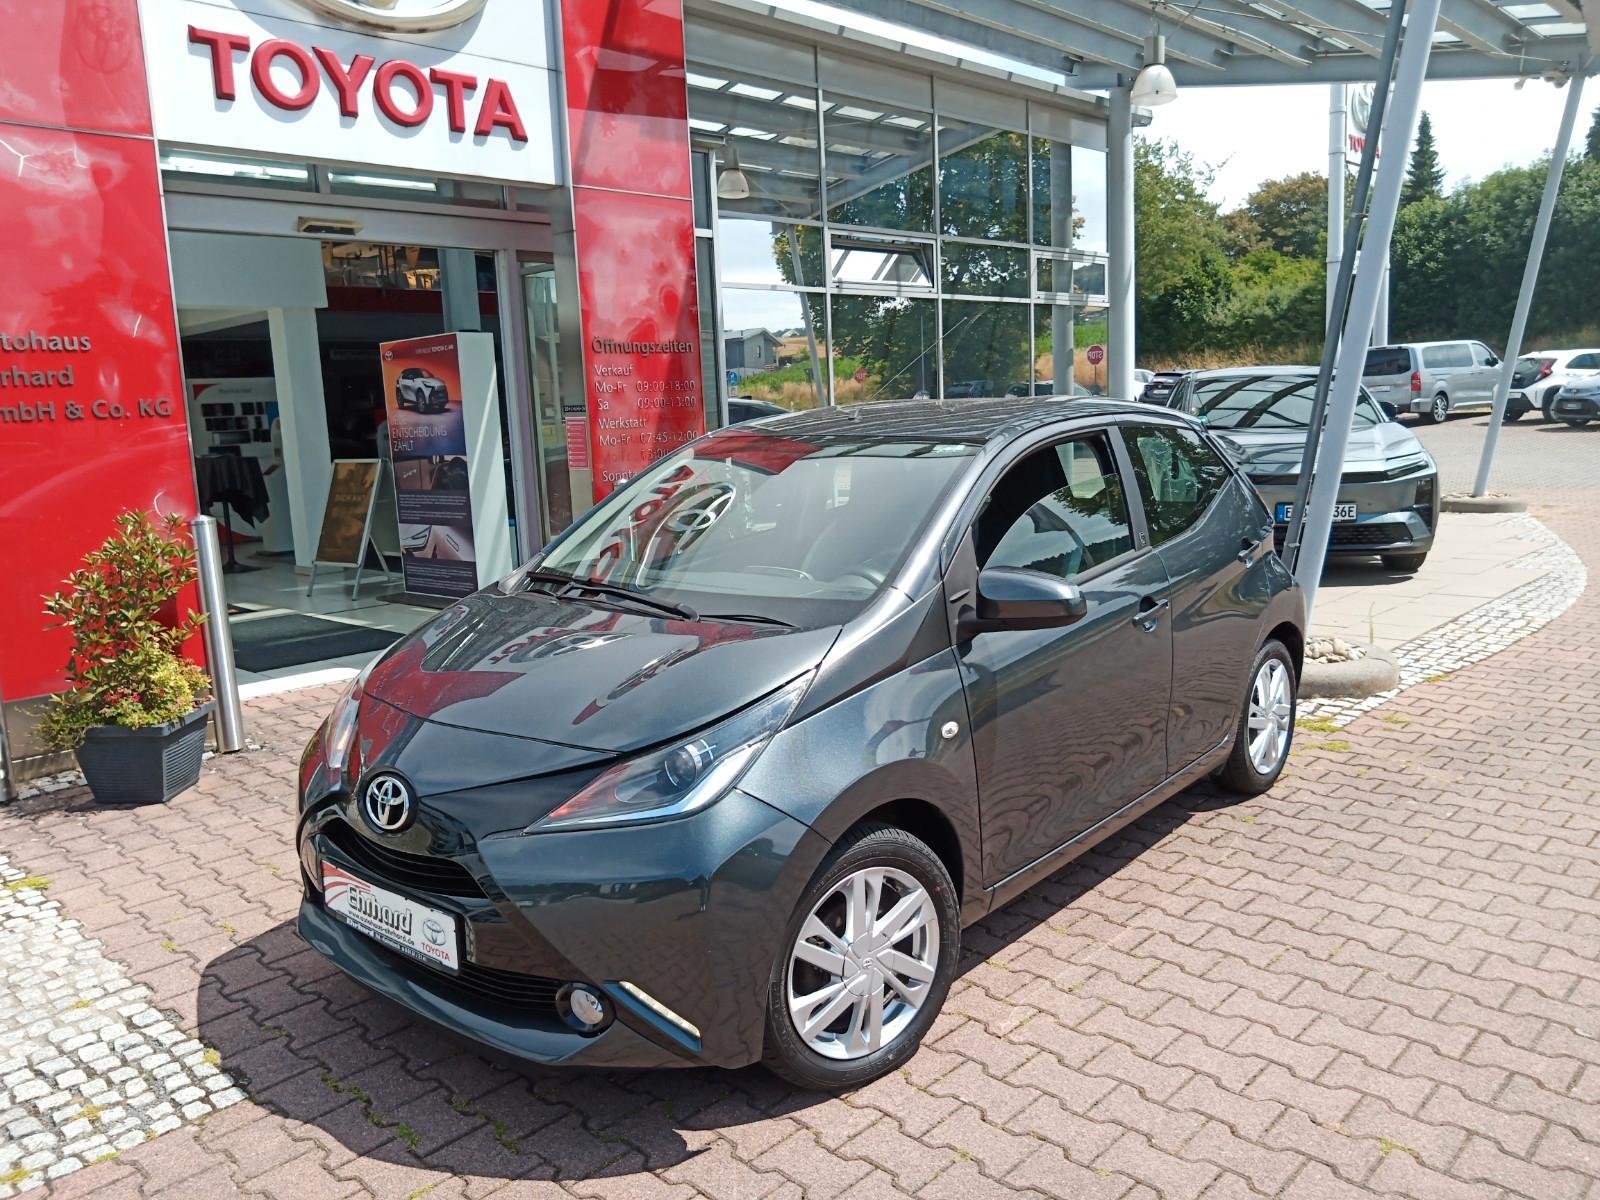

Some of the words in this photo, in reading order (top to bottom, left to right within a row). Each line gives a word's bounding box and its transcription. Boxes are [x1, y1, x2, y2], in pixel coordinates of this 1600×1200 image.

[188, 24, 529, 142] TOYOTA
[592, 336, 694, 357] Öffnungszeiten
[594, 363, 633, 377] Verkauf
[595, 381, 628, 394] Mo-Fr
[65, 400, 84, 419] &
[92, 399, 131, 418] Co.
[139, 398, 173, 417] KG
[597, 398, 609, 410] Sa
[598, 417, 647, 429] Werkstatt
[599, 435, 631, 446] Mo-Fr
[421, 942, 451, 962] TOYOTA
